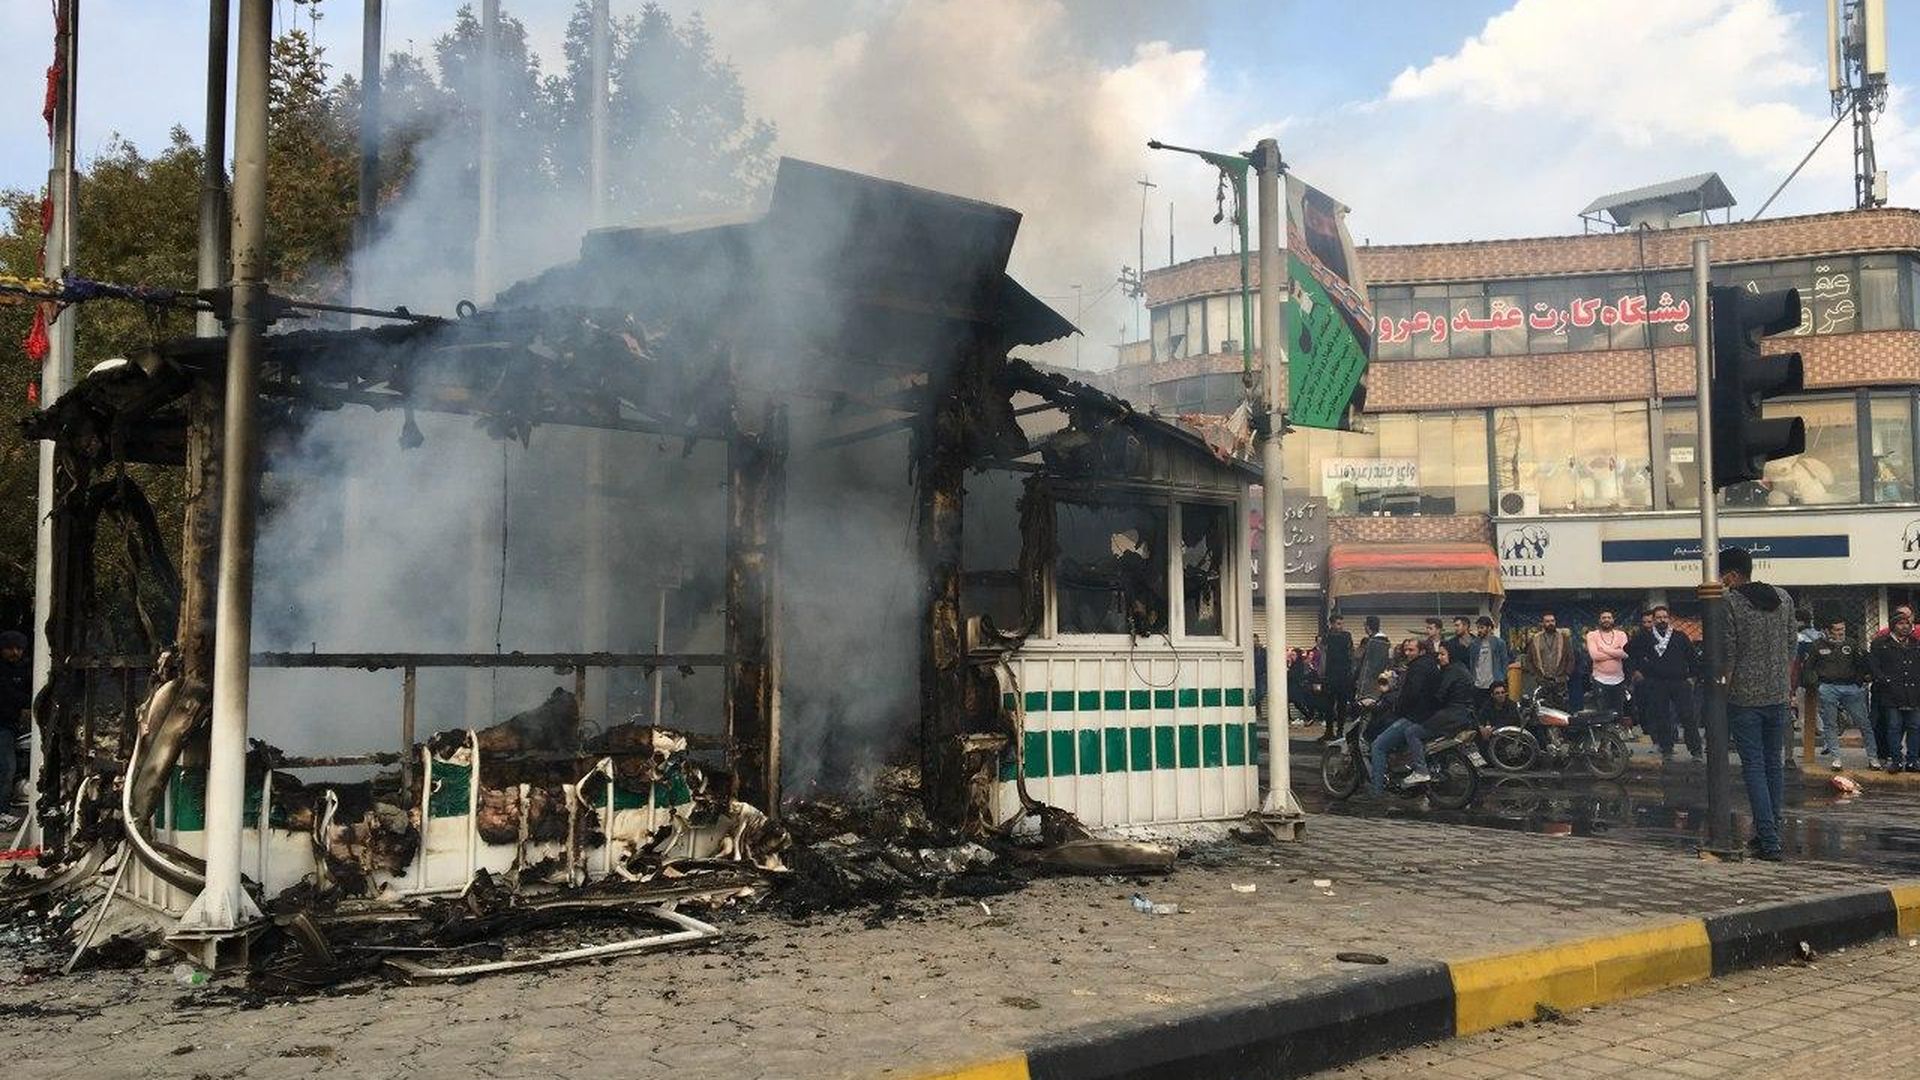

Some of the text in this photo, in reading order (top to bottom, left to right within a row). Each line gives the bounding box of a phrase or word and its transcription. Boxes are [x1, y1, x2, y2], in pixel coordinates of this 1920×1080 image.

[1377, 311, 1431, 342] عرو
[1450, 300, 1524, 332] عقد
[1529, 299, 1602, 335] کارت
[1600, 292, 1690, 333] یشگاه
[1283, 525, 1315, 547] ورزش
